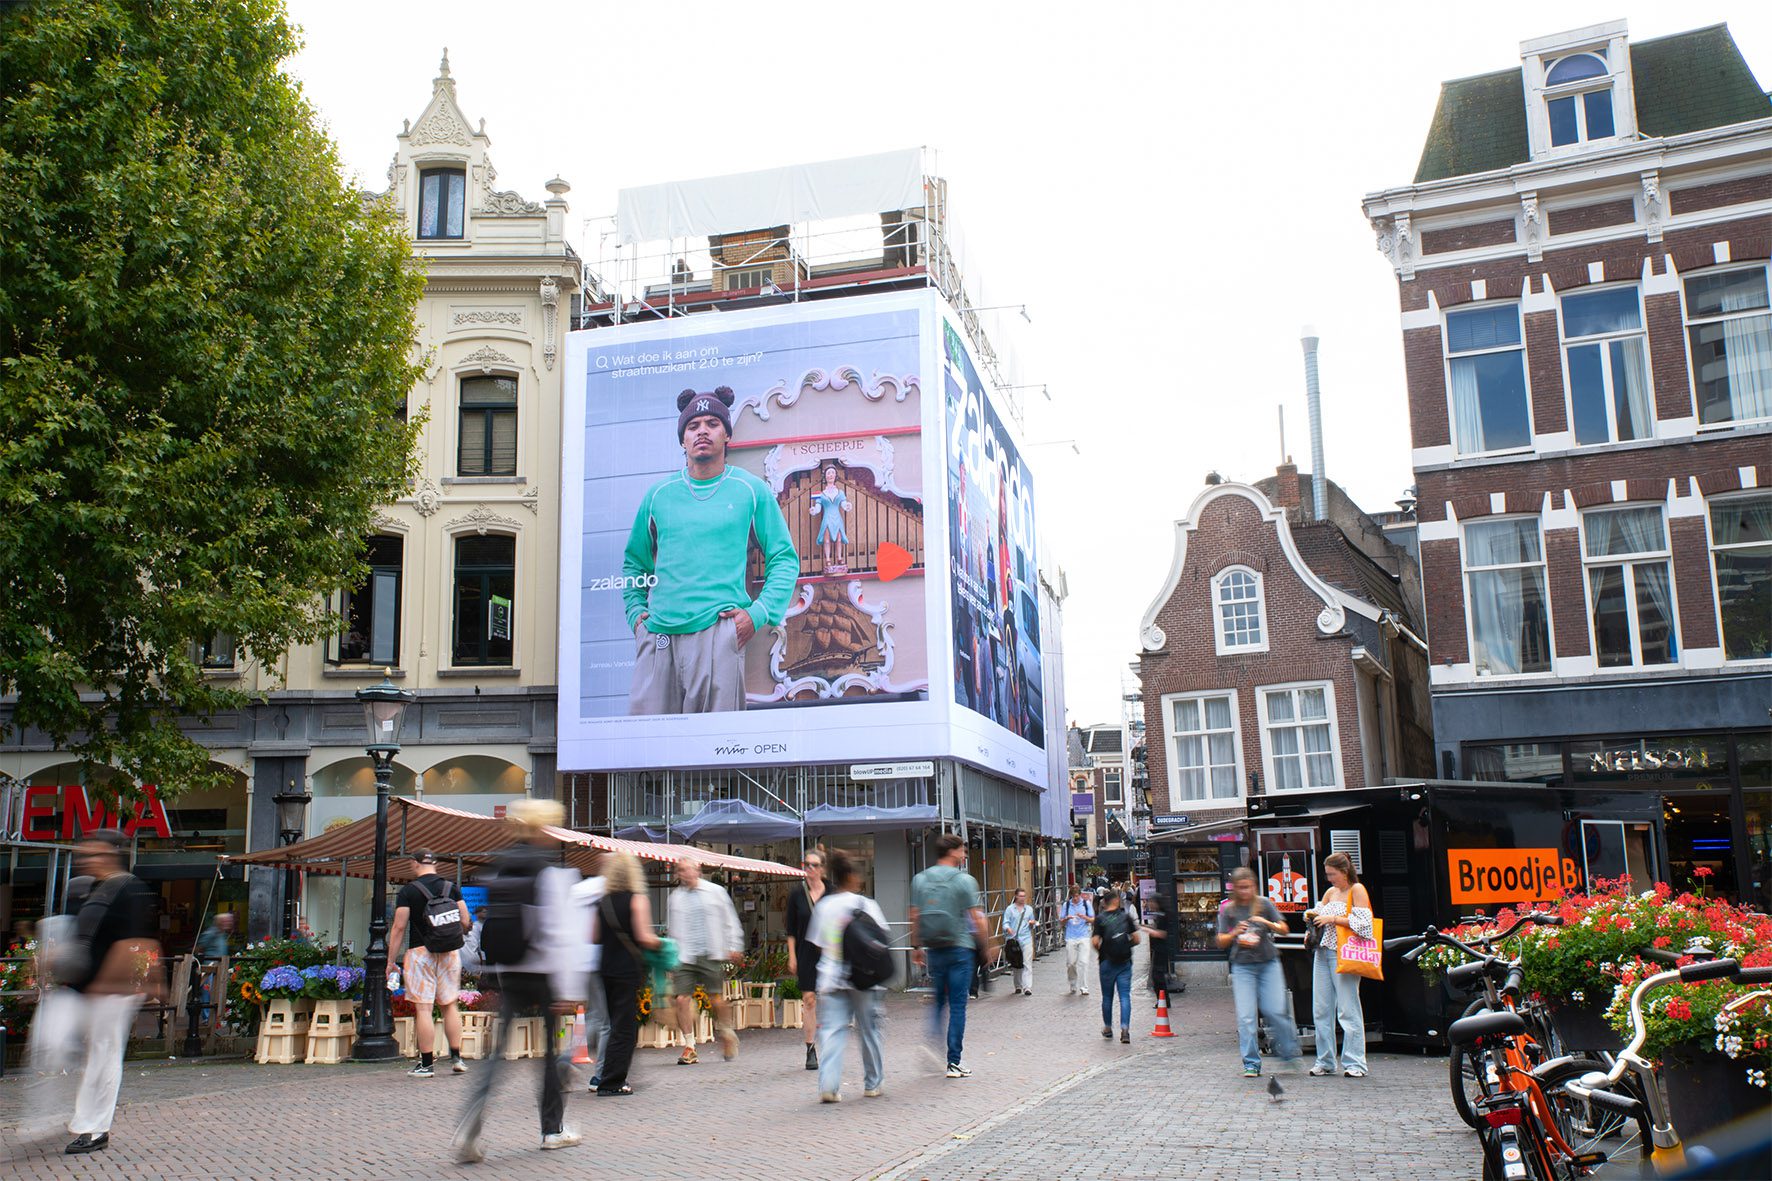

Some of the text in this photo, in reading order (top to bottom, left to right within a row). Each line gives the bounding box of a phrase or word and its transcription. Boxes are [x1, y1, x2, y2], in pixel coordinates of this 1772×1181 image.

[611, 351, 763, 379] straatmuzikant 2.0 te zijn?
[612, 346, 719, 366] Wat doe ik aan om
[696, 399, 710, 412] NY
[800, 439, 865, 455] SCHEEPJE
[590, 572, 659, 591] zalando
[754, 743, 787, 755] OPEN
[1589, 748, 1709, 772] NELSON
[1627, 772, 1674, 781] PREMIUM
[0, 784, 173, 841] EMA
[1156, 816, 1187, 824] OUDEGRACHT
[1458, 856, 1556, 898] Broodje
[428, 908, 461, 927] VANS
[1348, 935, 1378, 949] sam
[1341, 944, 1382, 968] friday
